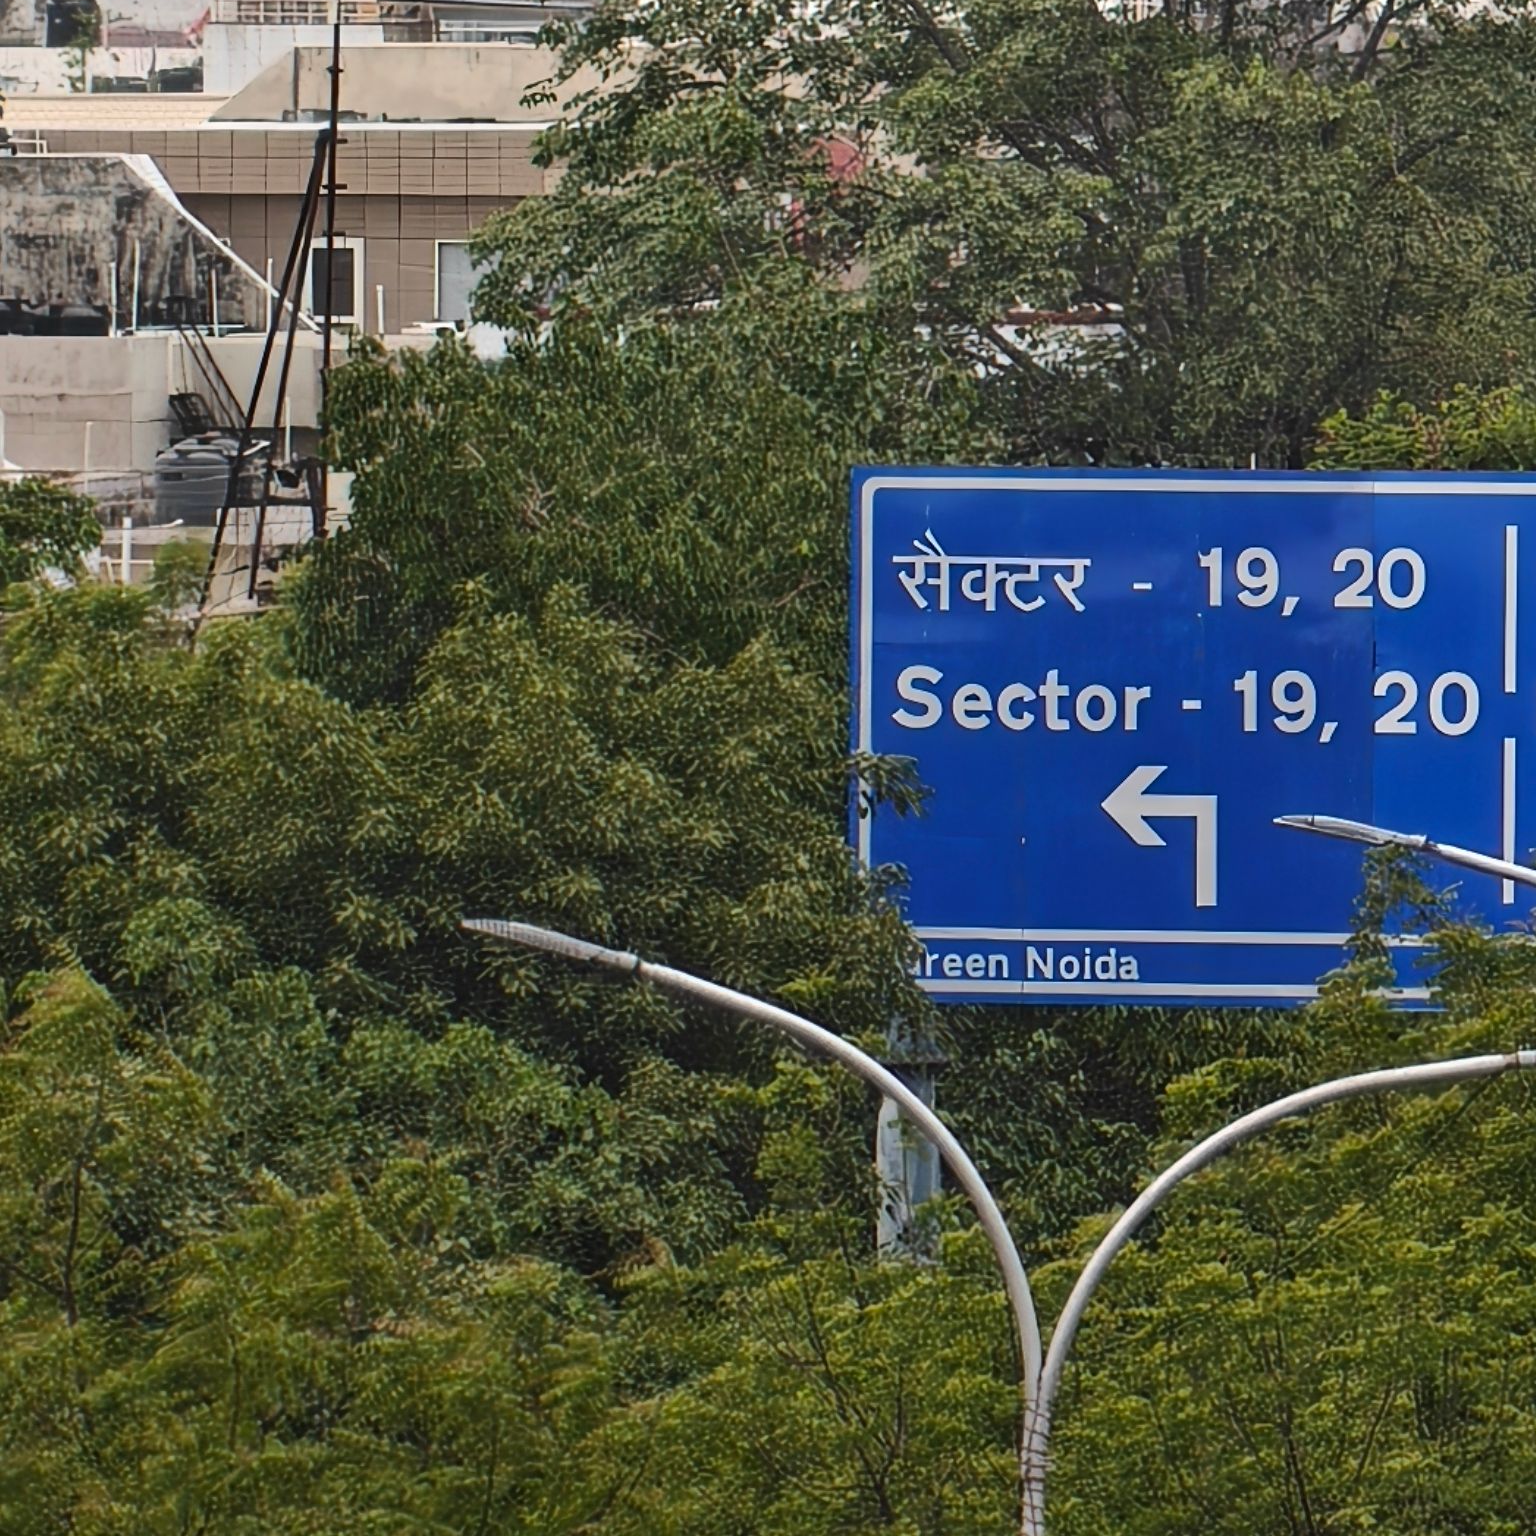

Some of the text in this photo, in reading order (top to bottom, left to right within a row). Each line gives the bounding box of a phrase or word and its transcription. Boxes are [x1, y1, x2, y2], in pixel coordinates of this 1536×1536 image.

[892, 529, 1091, 612] सैक्टर
[1199, 547, 1300, 616] 19,
[1332, 547, 1427, 609] 20
[892, 665, 1151, 731] Sector
[1234, 670, 1338, 743] 19,
[1373, 670, 1480, 736] 20
[915, 946, 1140, 980] reen Noida
